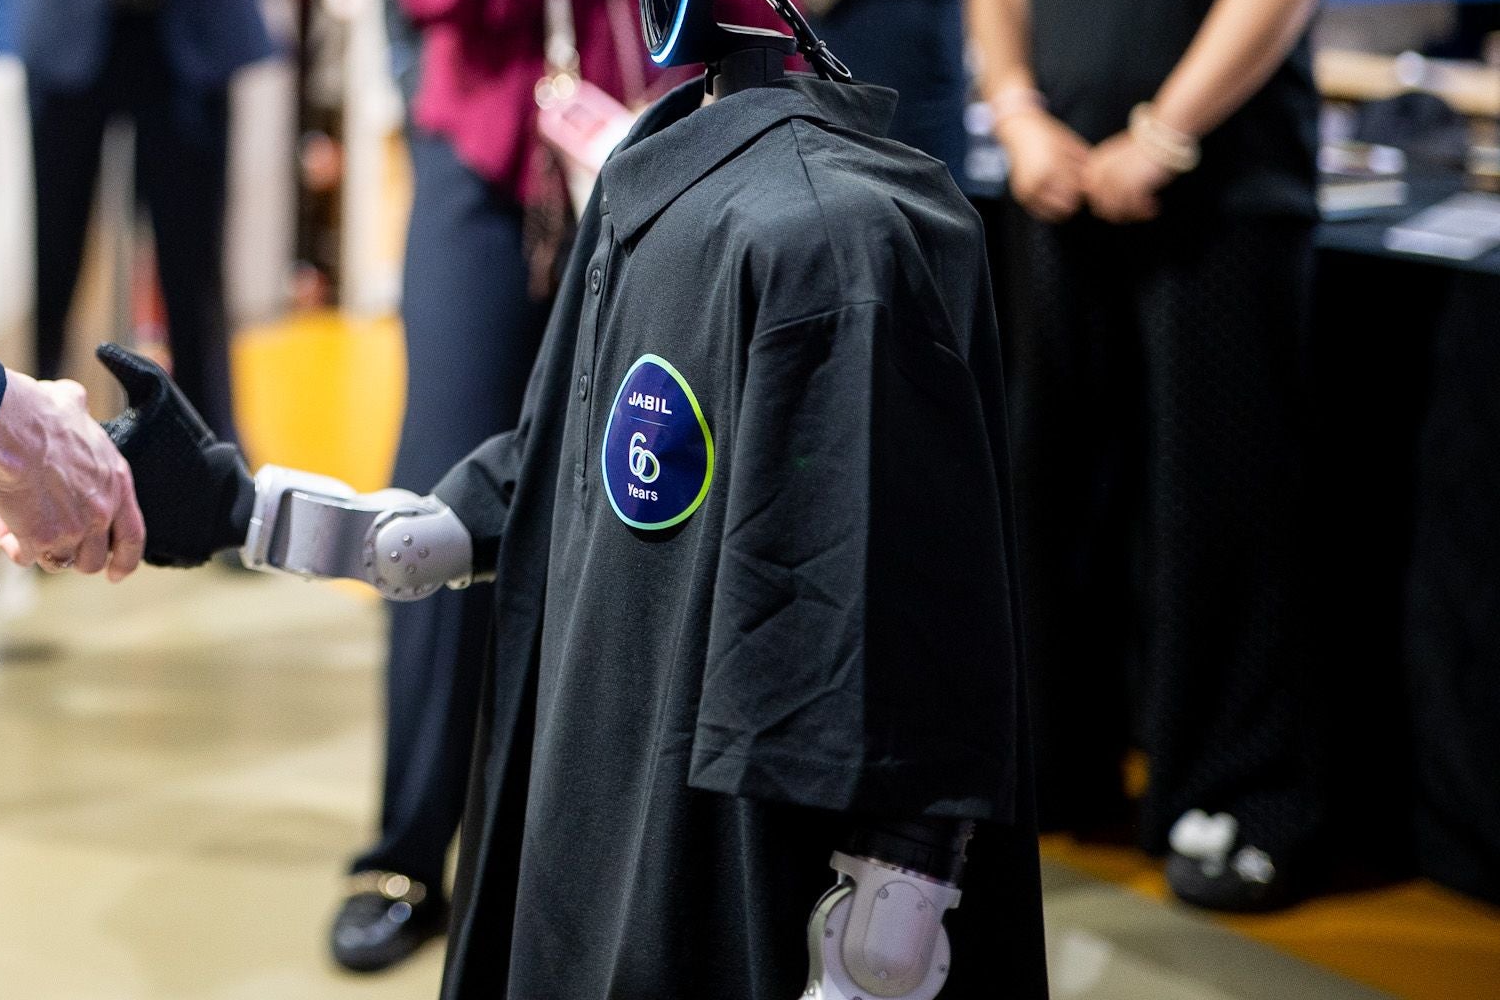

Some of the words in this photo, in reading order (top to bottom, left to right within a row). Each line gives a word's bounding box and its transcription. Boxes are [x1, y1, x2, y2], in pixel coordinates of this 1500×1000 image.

[628, 391, 672, 415] JABIL
[629, 432, 660, 483] 60
[628, 483, 658, 501] Years
